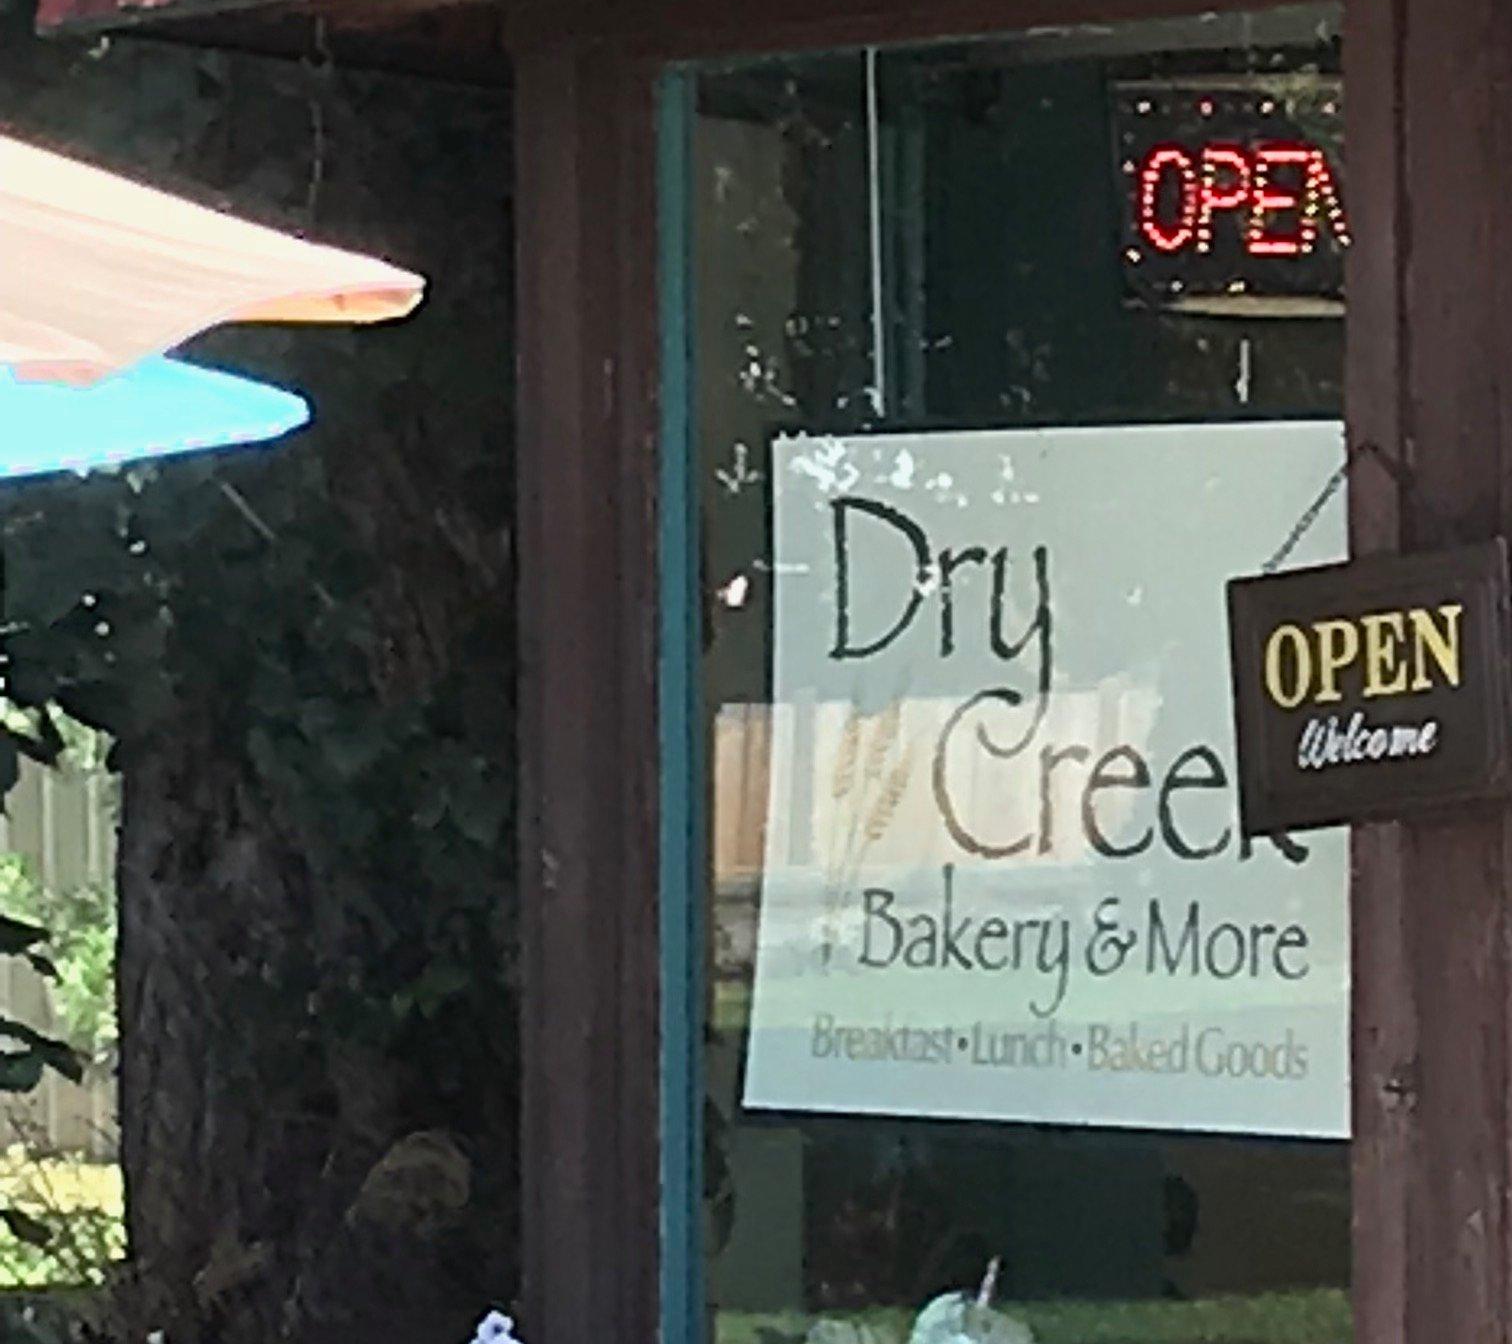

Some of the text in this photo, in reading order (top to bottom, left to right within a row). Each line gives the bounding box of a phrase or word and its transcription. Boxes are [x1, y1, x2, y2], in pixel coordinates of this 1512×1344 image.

[1141, 149, 1351, 253] OPEN
[828, 496, 1053, 758] Dry
[1265, 604, 1463, 708] OPEN
[1297, 711, 1438, 770] Welcome
[858, 863, 1071, 1016] Bakery
[1147, 899, 1310, 979] More
[1196, 1026, 1310, 1081] Goods
